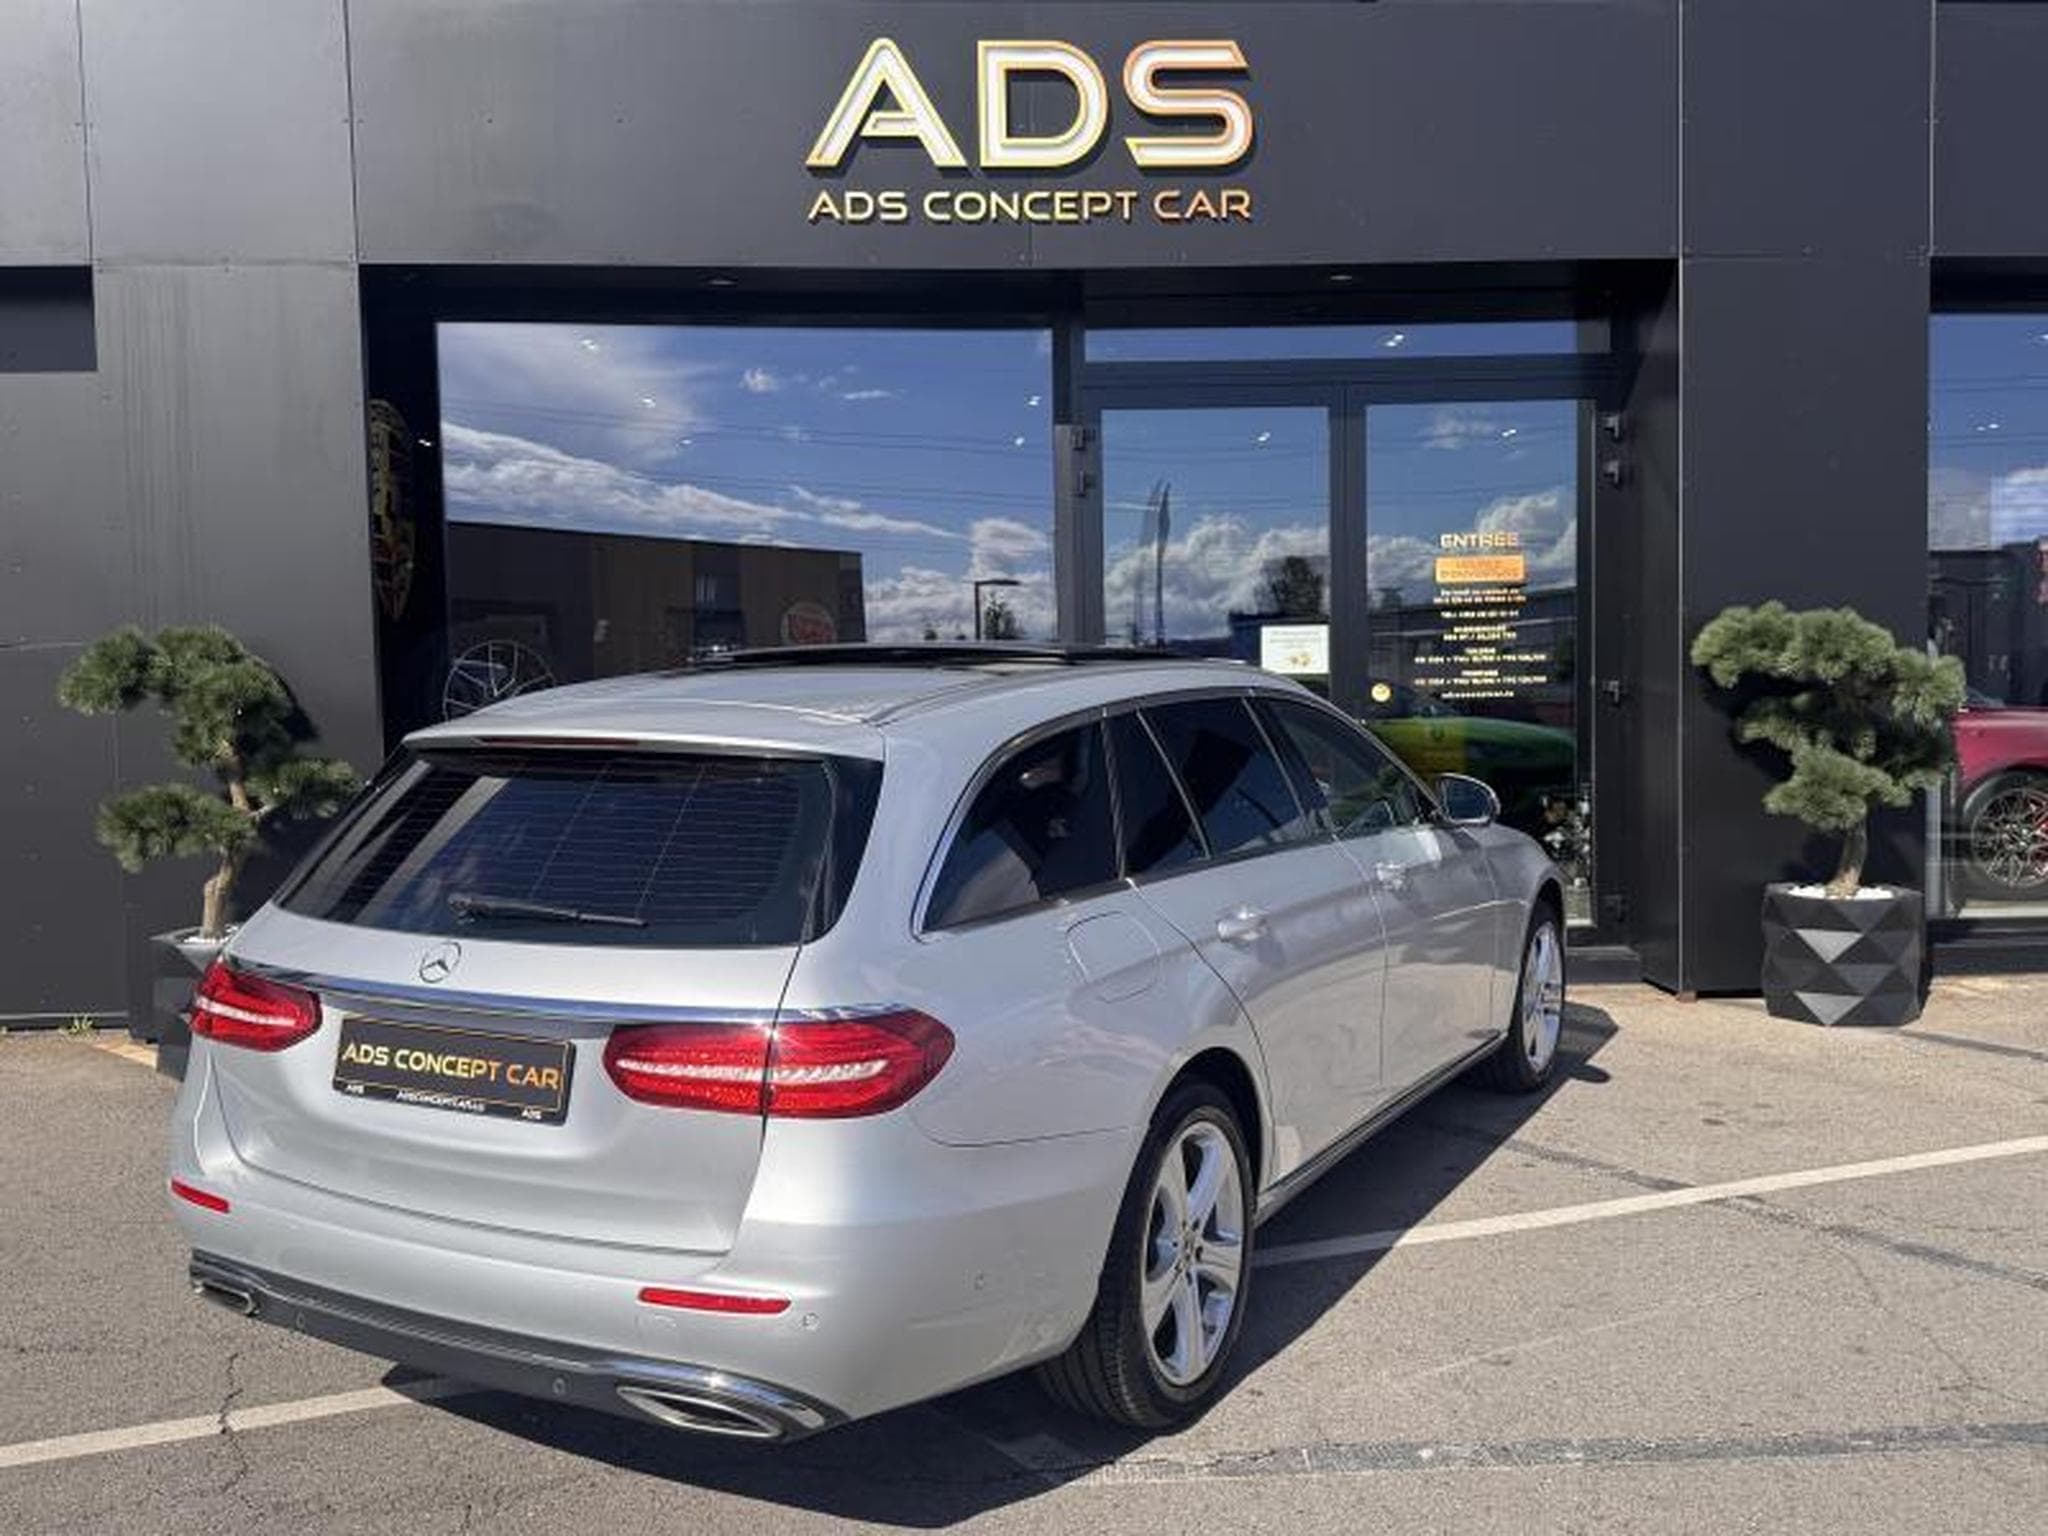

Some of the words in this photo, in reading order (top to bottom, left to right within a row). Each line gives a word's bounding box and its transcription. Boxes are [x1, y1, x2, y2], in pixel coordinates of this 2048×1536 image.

[805, 37, 1253, 167] ADS
[808, 190, 908, 221] ADS
[923, 190, 1138, 221] CONCEPT
[1154, 189, 1251, 219] CAR
[342, 1043, 389, 1066] ADS
[394, 1049, 502, 1082] CONCEPT
[506, 1064, 561, 1090] CAR
